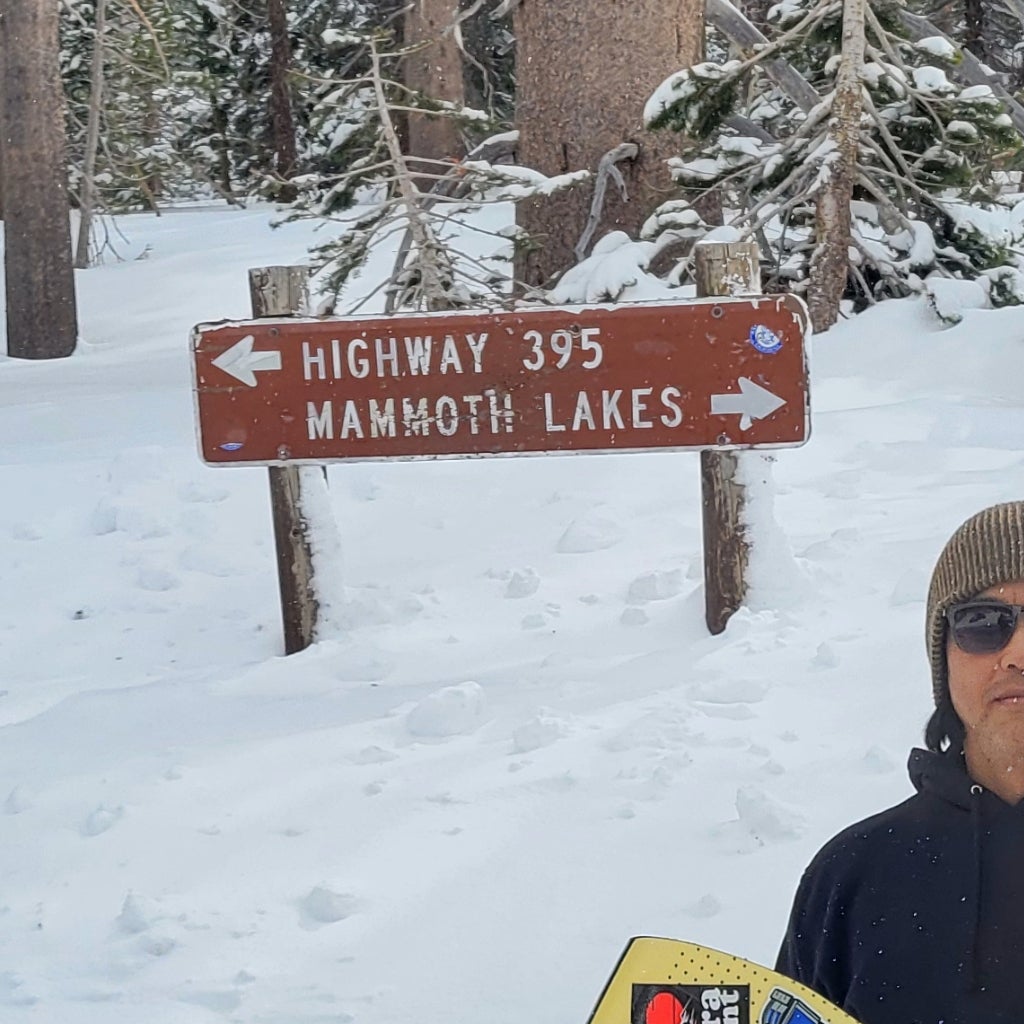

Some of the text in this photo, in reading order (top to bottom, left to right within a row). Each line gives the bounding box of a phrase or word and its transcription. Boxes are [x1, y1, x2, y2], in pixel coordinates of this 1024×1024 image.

[302, 327, 603, 380] HIGHWAY 395
[306, 386, 683, 440] MAMMOTH LAKES
